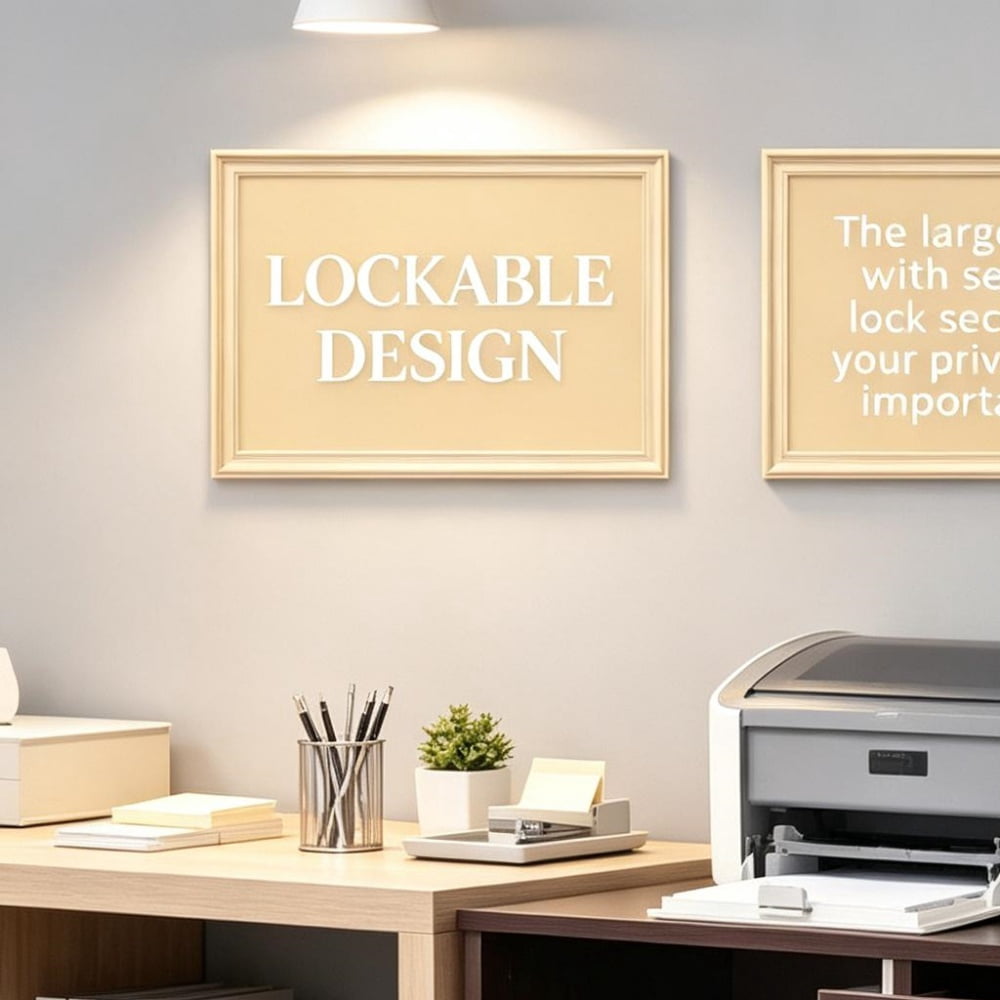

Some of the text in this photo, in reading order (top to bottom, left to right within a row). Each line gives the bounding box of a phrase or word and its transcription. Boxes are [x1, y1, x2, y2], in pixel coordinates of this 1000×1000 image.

[834, 214, 907, 248] The
[265, 253, 614, 307] LOCKABLE
[861, 257, 948, 291] with
[850, 299, 927, 334] lock
[317, 328, 567, 383] DESIGN
[832, 350, 918, 383] your
